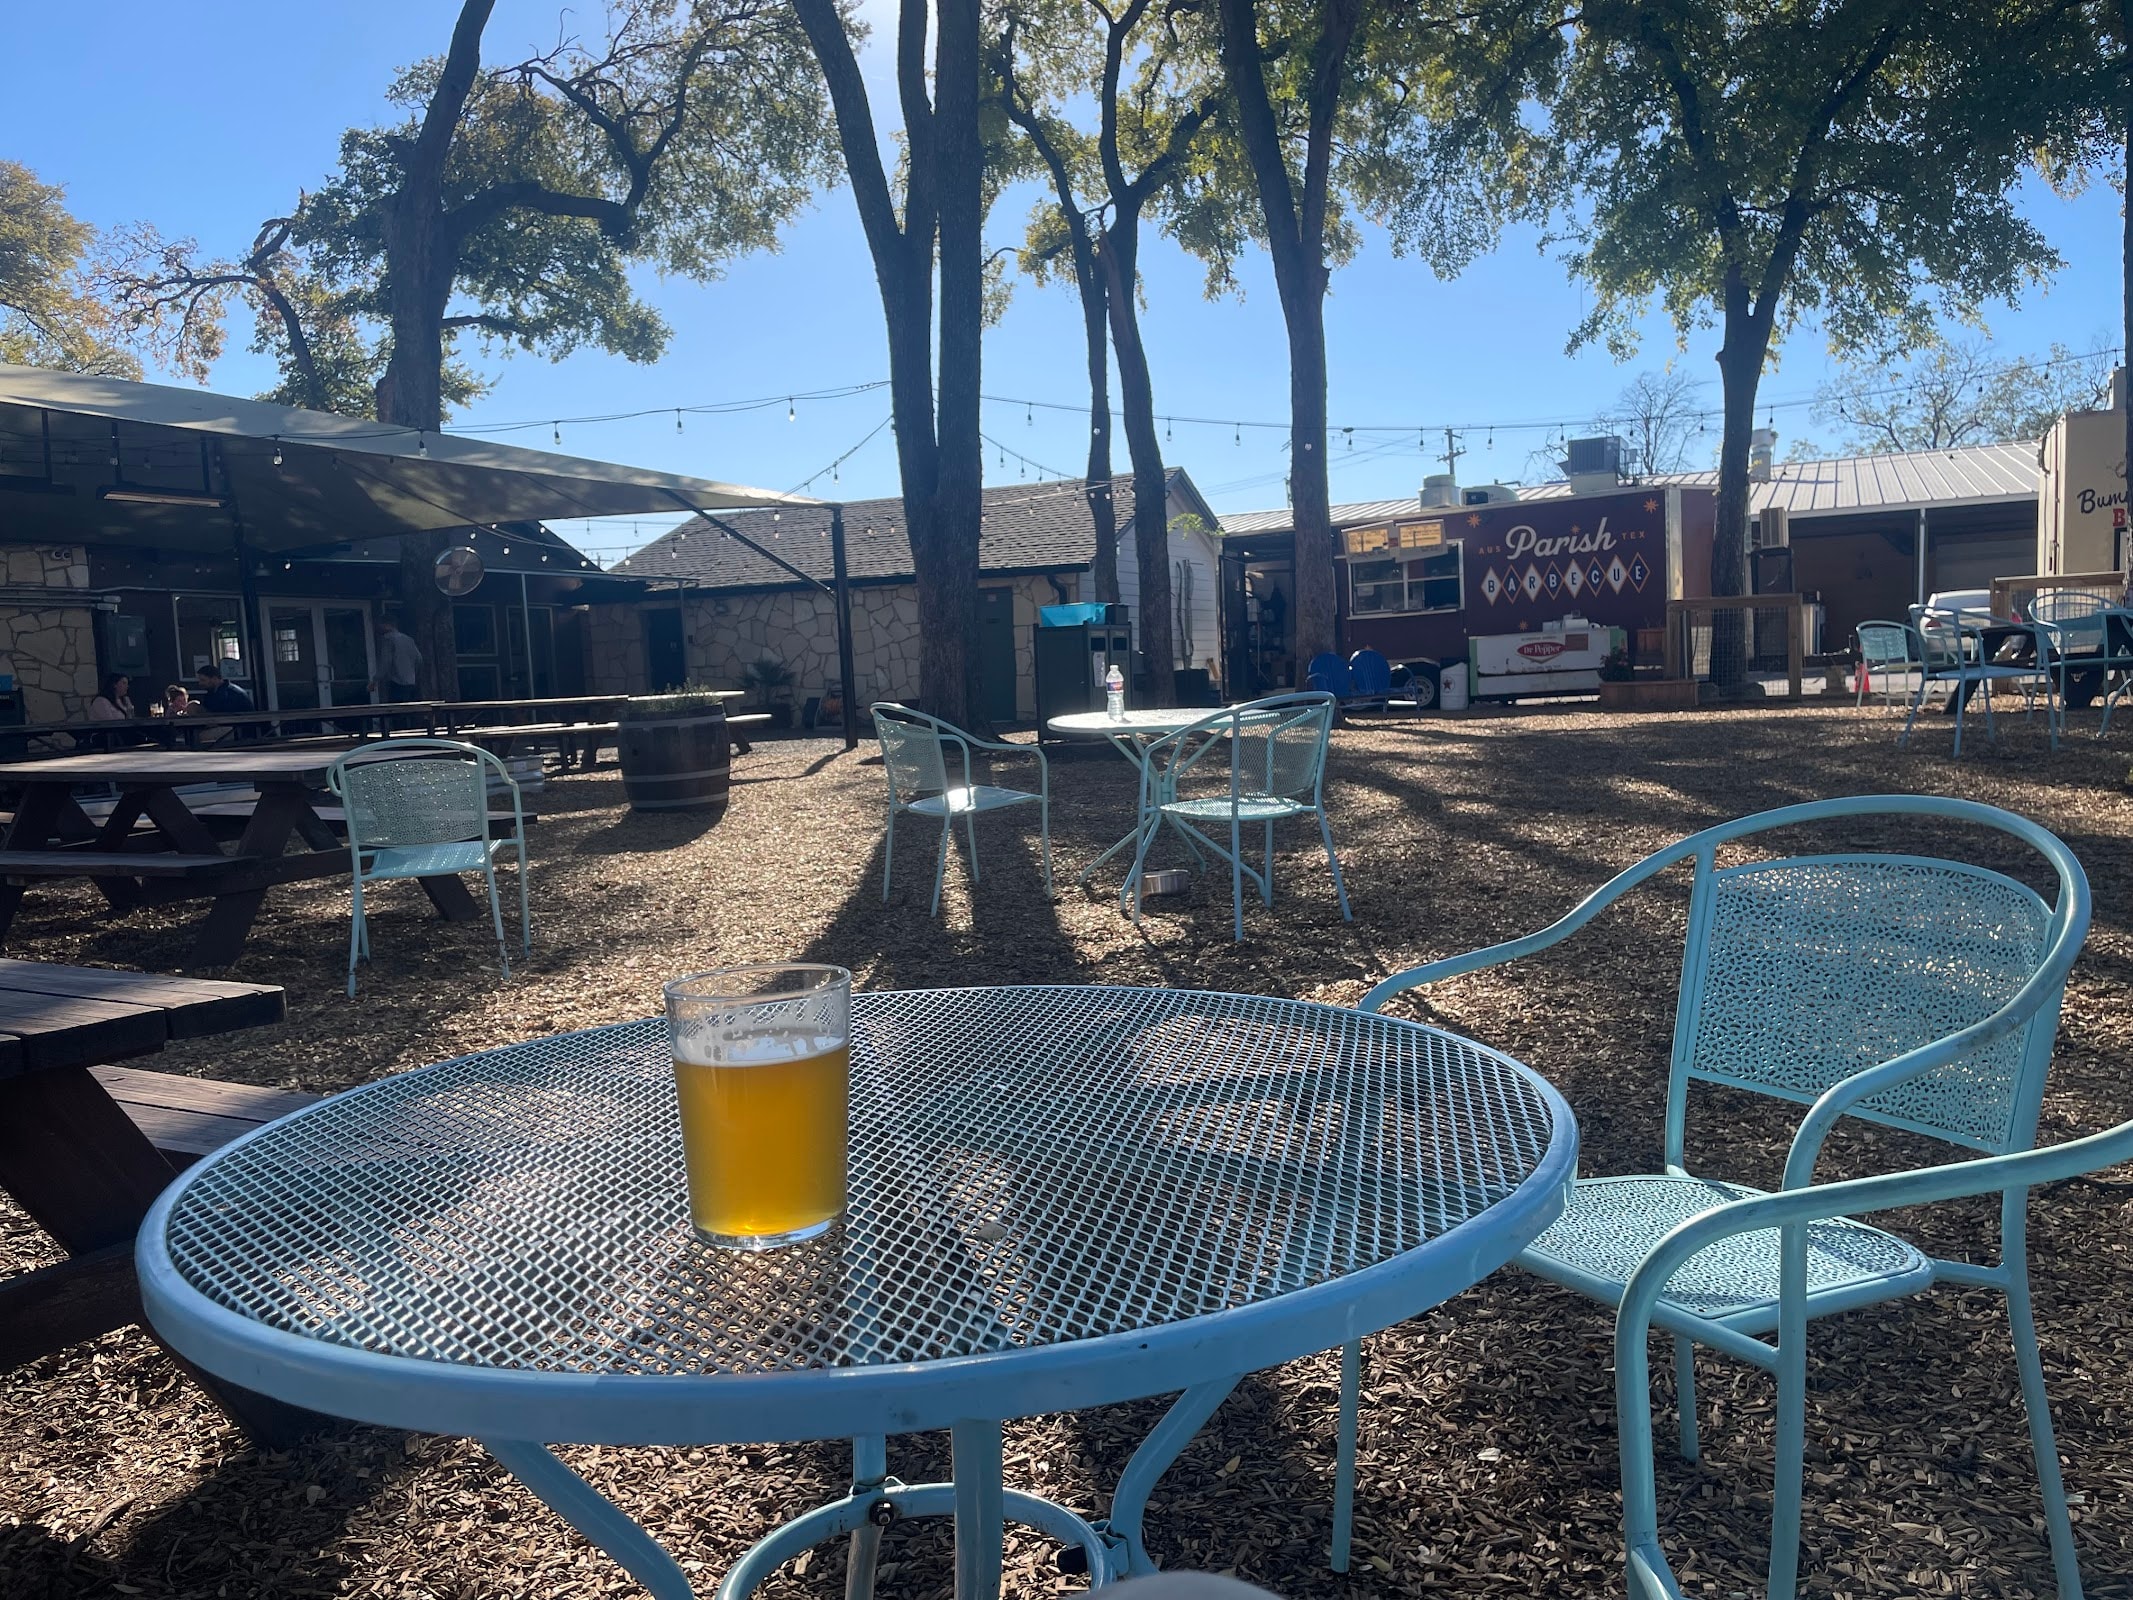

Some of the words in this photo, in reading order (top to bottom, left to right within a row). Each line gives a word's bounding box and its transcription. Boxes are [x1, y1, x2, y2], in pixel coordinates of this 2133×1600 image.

[2077, 488, 2129, 514] Bum
[1478, 545, 1501, 555] AUS
[1505, 517, 1617, 560] Parish
[1621, 531, 1646, 540] TEX
[1487, 564, 1643, 594] BARBECUE
[1523, 646, 1534, 655] Dr
[1534, 643, 1562, 656] Pepper
